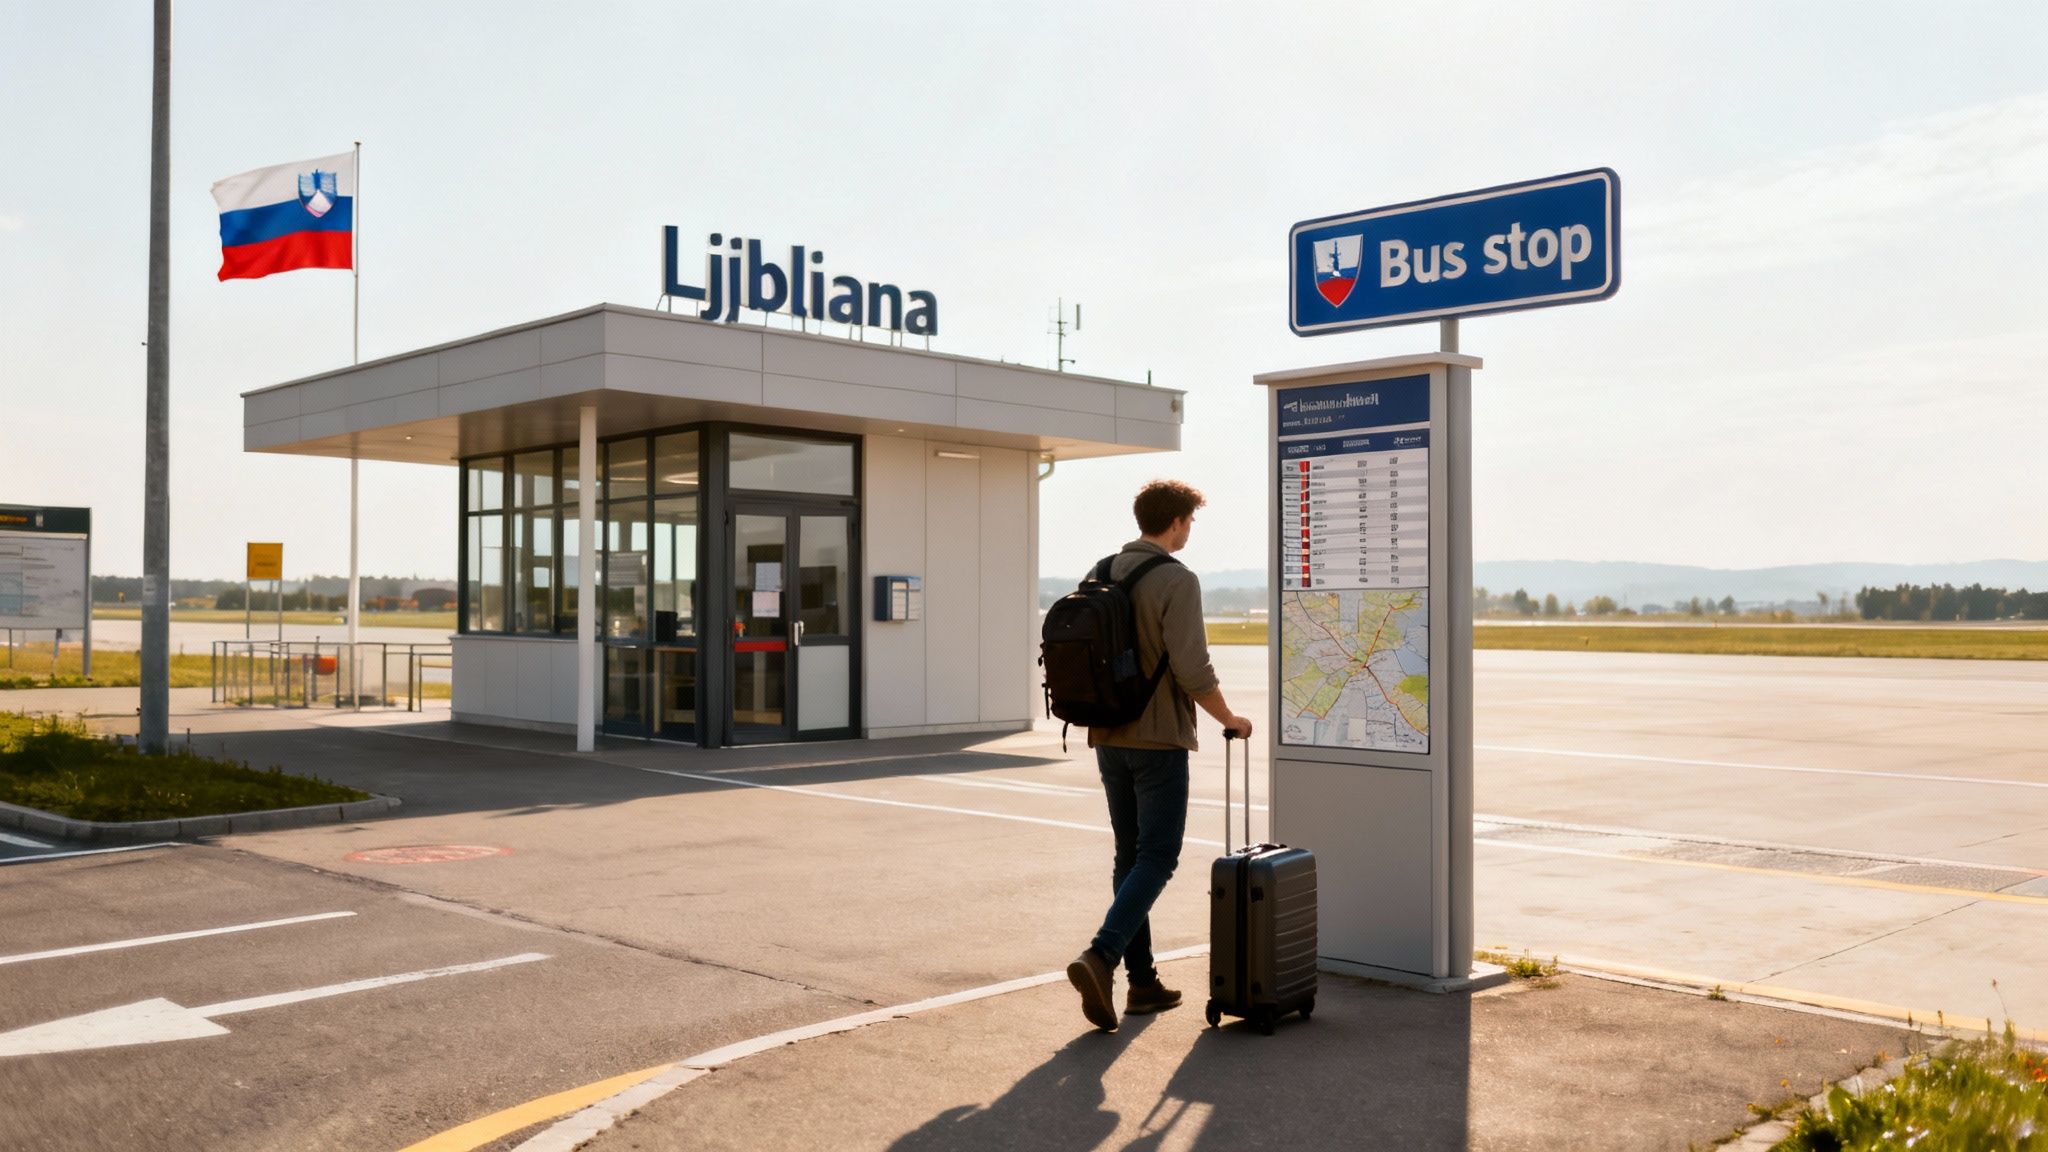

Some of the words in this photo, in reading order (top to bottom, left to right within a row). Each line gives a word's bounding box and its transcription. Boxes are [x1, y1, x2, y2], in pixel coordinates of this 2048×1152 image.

[662, 225, 938, 336] Ljjbliana
[1380, 239, 1467, 288] Bus
[1483, 222, 1592, 280] stop
